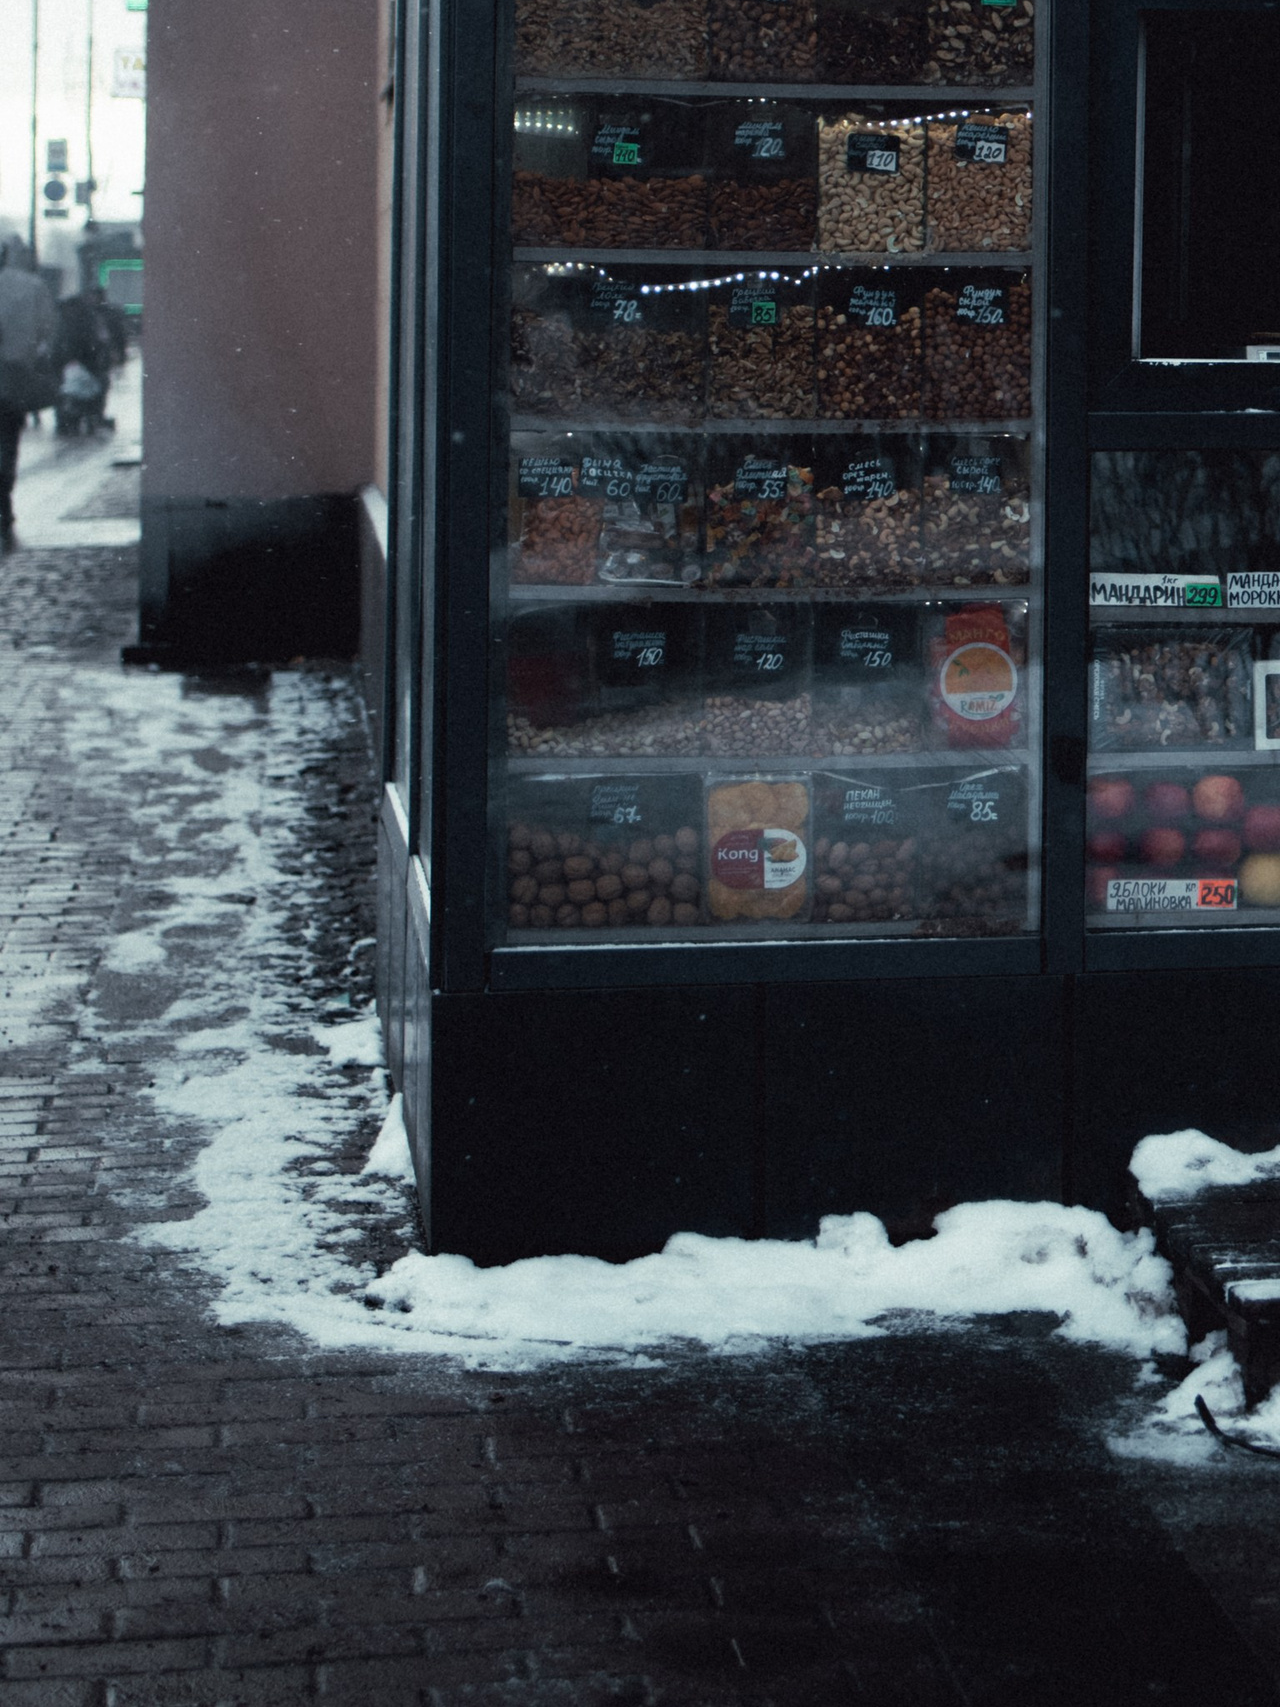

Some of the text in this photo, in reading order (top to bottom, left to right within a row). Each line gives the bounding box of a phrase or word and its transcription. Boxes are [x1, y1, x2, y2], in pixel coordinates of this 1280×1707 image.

[974, 145, 1004, 162] 120
[753, 306, 775, 323] 85
[605, 479, 631, 497] 60
[1090, 582, 1220, 607] МАНДАРИН 299
[845, 788, 882, 802] ПЕКАН
[717, 847, 760, 863] Kong
[1109, 881, 1167, 899] ЯБЛОКИ
[1115, 885, 1235, 912] МАЛИНОВКА 250
